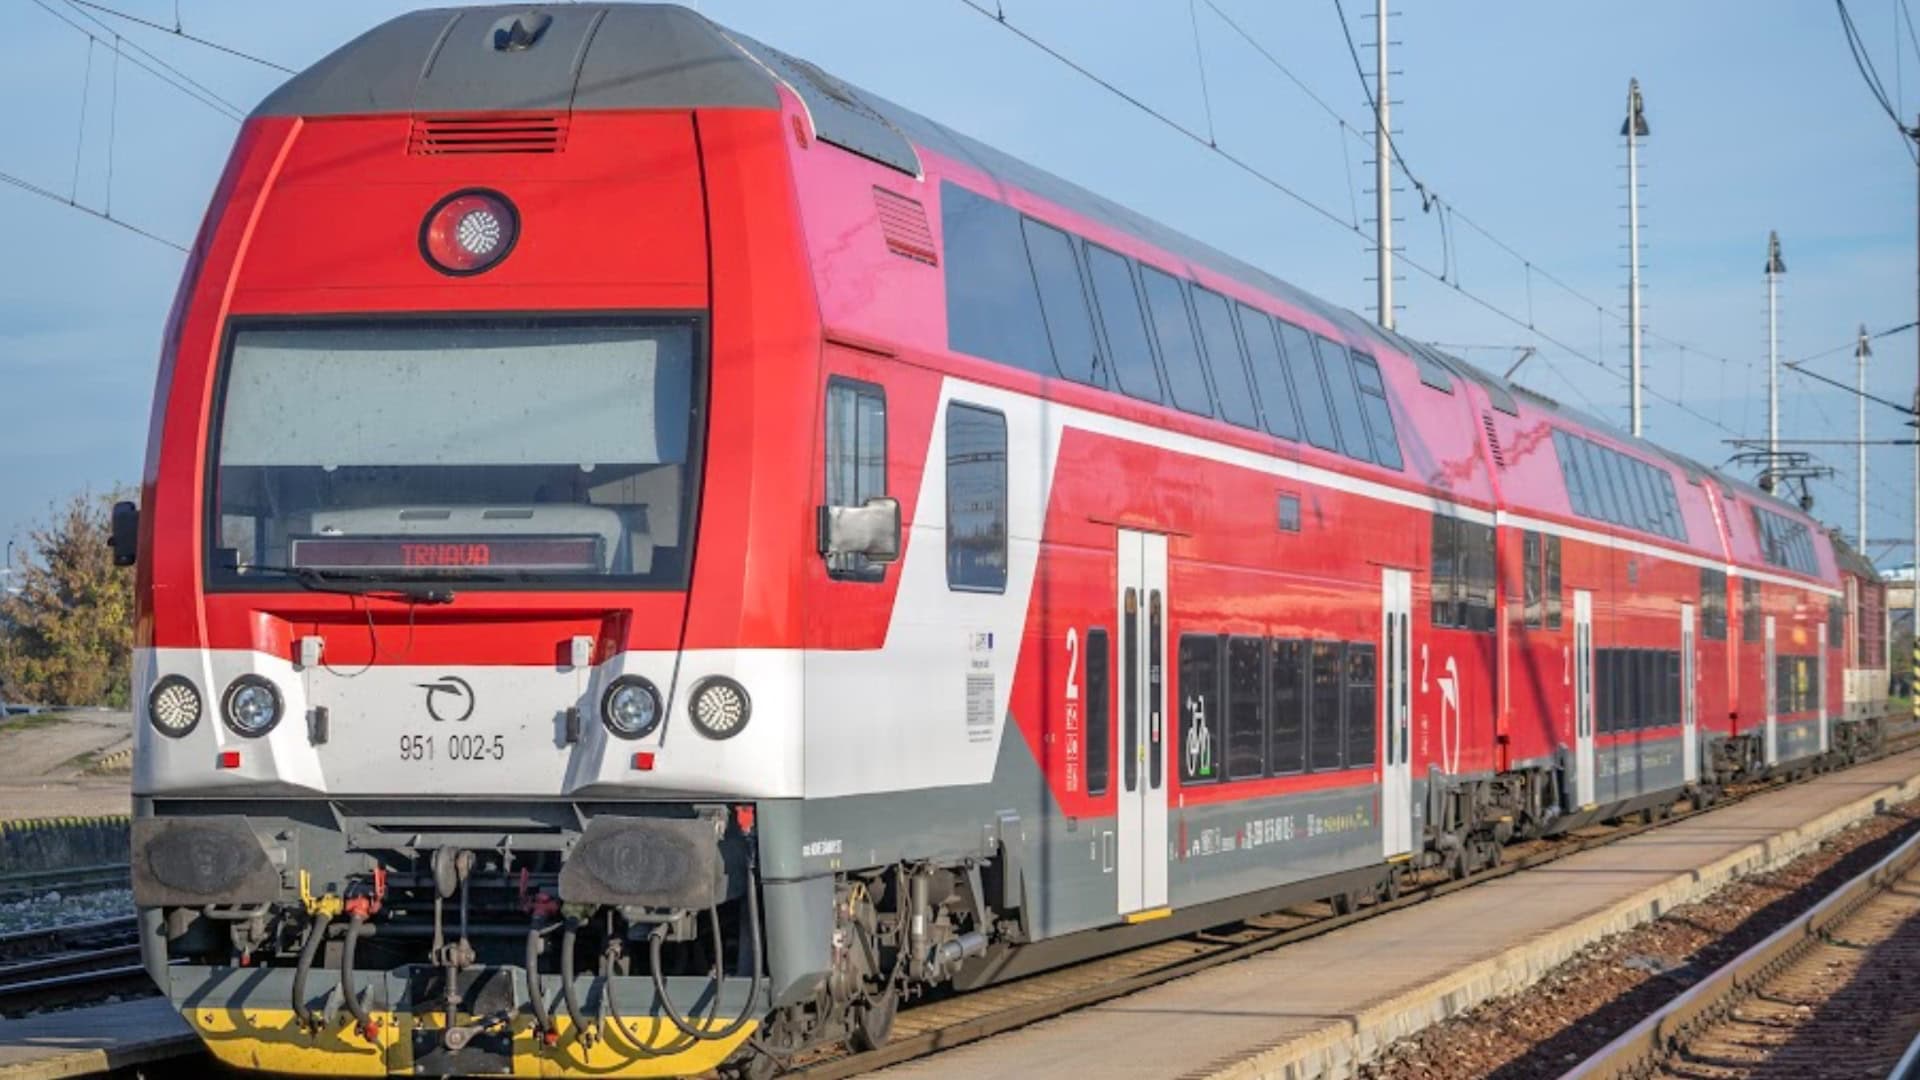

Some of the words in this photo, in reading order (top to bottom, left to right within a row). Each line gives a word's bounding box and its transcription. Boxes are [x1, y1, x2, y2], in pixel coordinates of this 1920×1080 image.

[1066, 627, 1079, 699] 2
[400, 734, 434, 760] 951
[447, 734, 504, 760] 002-5
